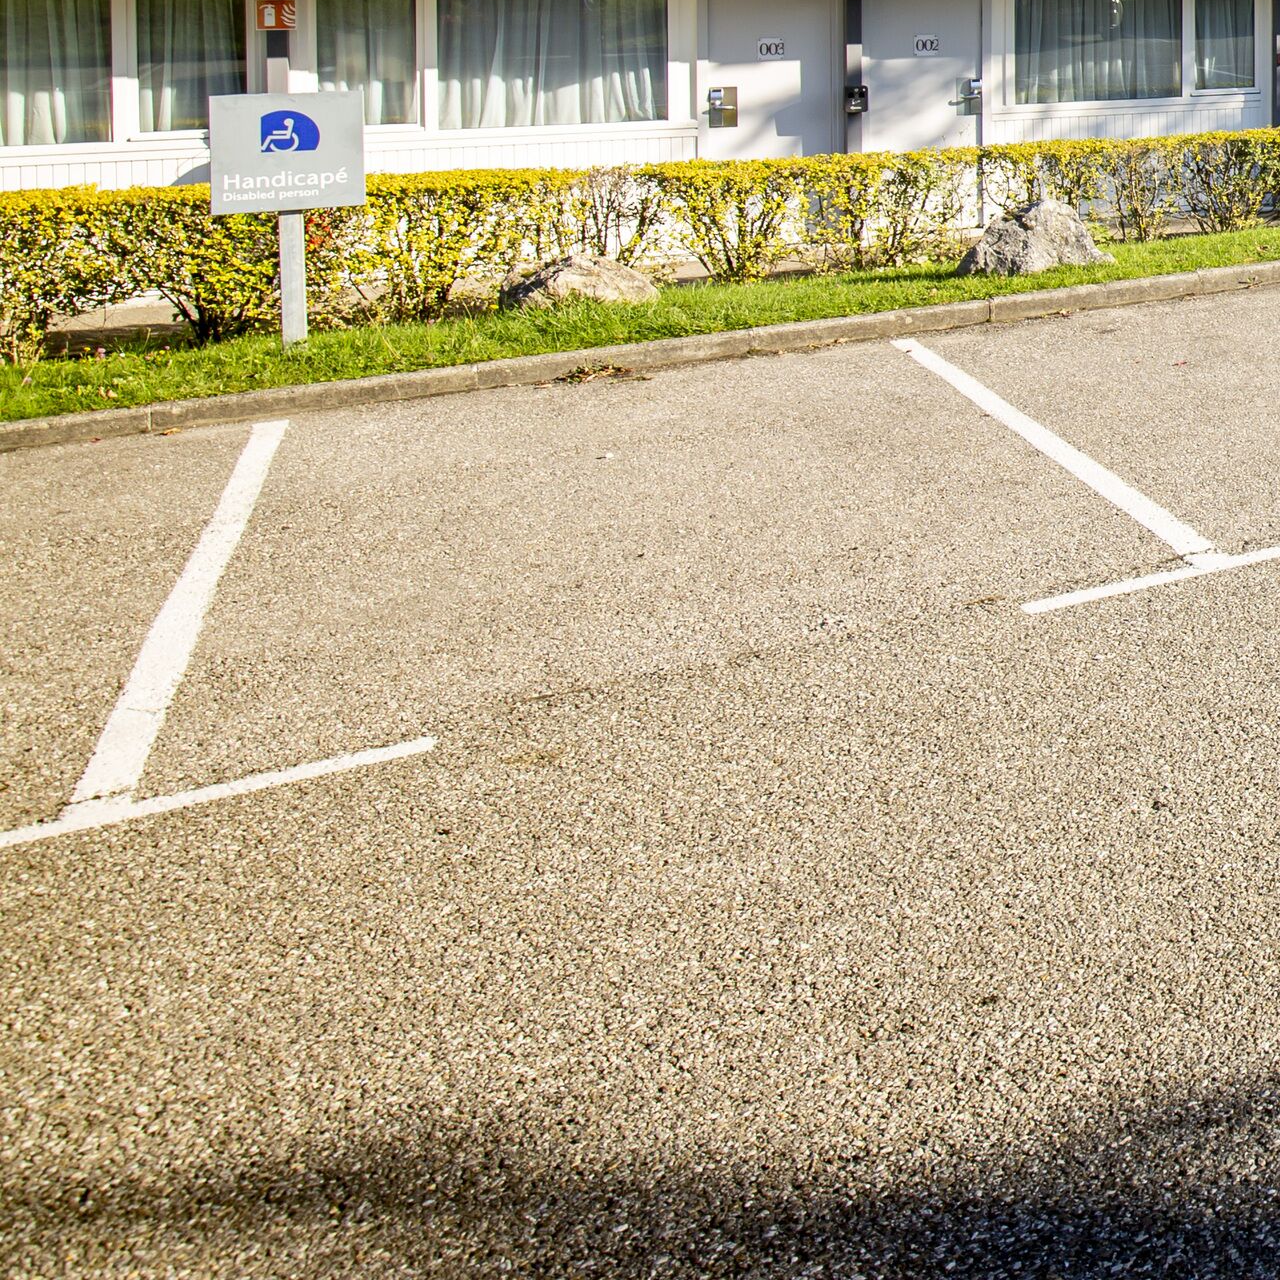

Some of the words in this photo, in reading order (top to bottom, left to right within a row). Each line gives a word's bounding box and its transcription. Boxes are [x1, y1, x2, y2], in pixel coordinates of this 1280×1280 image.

[759, 42, 784, 56] 003
[915, 38, 939, 52] 002
[223, 167, 348, 191] Handicapé
[223, 191, 275, 201] Disabled
[279, 188, 319, 200] person
